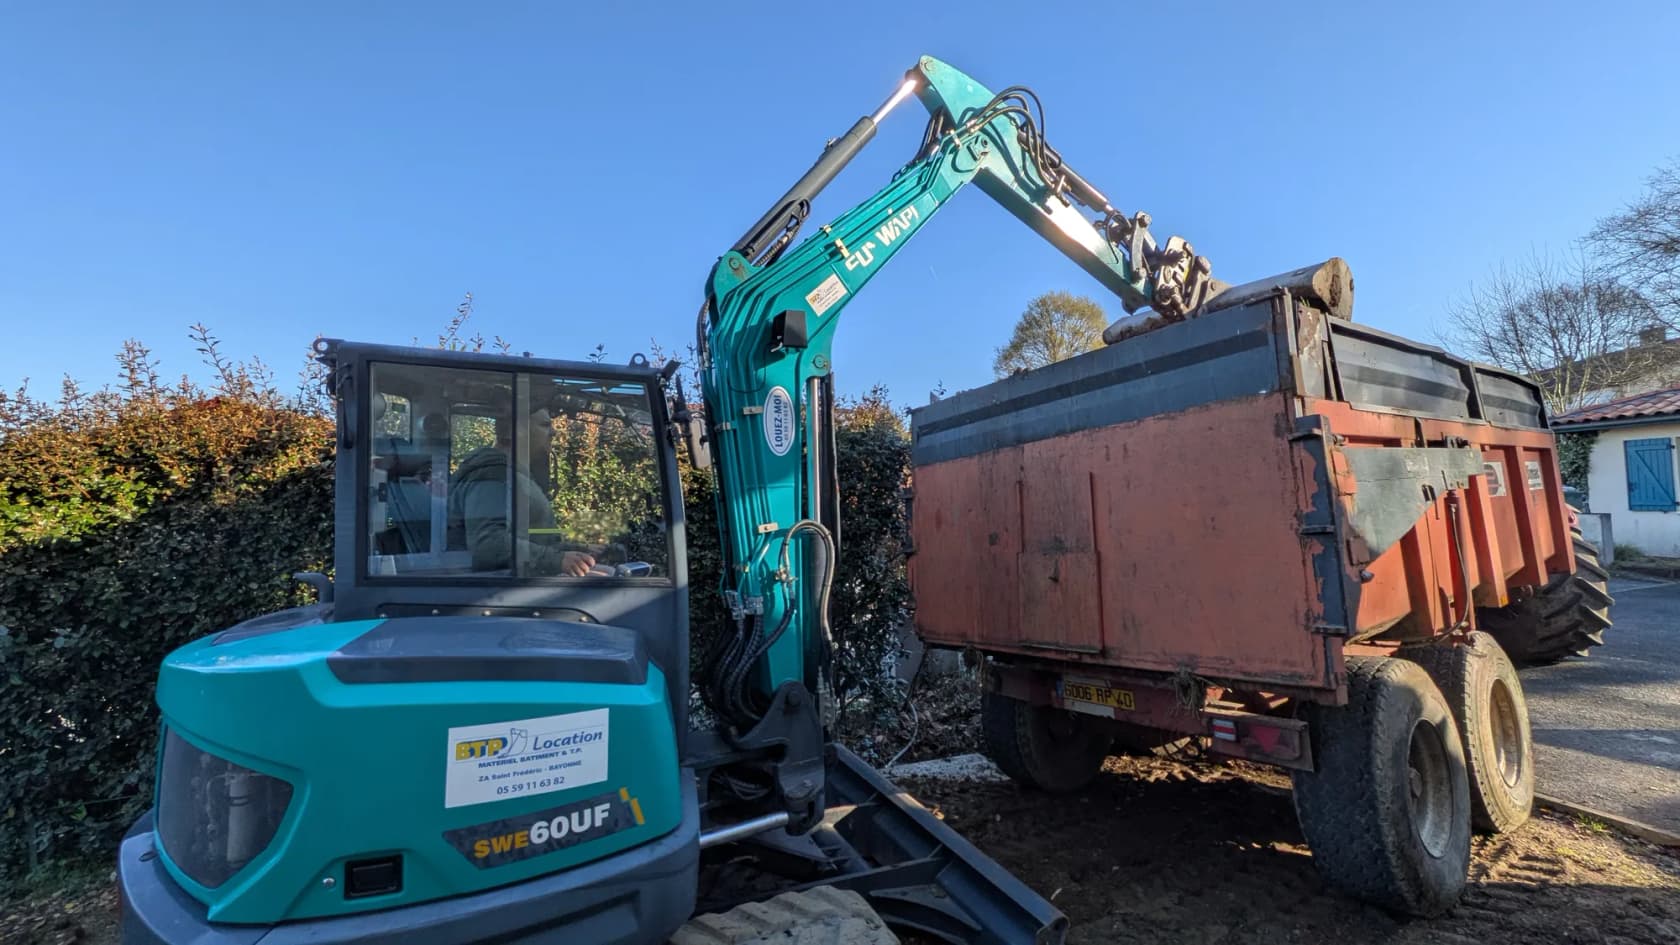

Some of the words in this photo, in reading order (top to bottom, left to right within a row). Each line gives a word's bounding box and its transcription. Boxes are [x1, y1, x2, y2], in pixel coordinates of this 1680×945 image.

[773, 394, 783, 447] LOUEZ-MOI
[1096, 687, 1112, 703] RP
[456, 737, 508, 761] BTP
[533, 731, 603, 750] Location
[478, 758, 518, 768] MATERIEL
[520, 752, 559, 762] BATIMENT
[492, 772, 510, 780] Saint
[549, 760, 581, 771] BAYONNE
[497, 785, 509, 795] 05
[512, 783, 524, 793] 59
[526, 781, 536, 790] 11
[540, 779, 551, 787] 63
[553, 776, 565, 785] 82
[473, 803, 611, 858] SWE60UF
